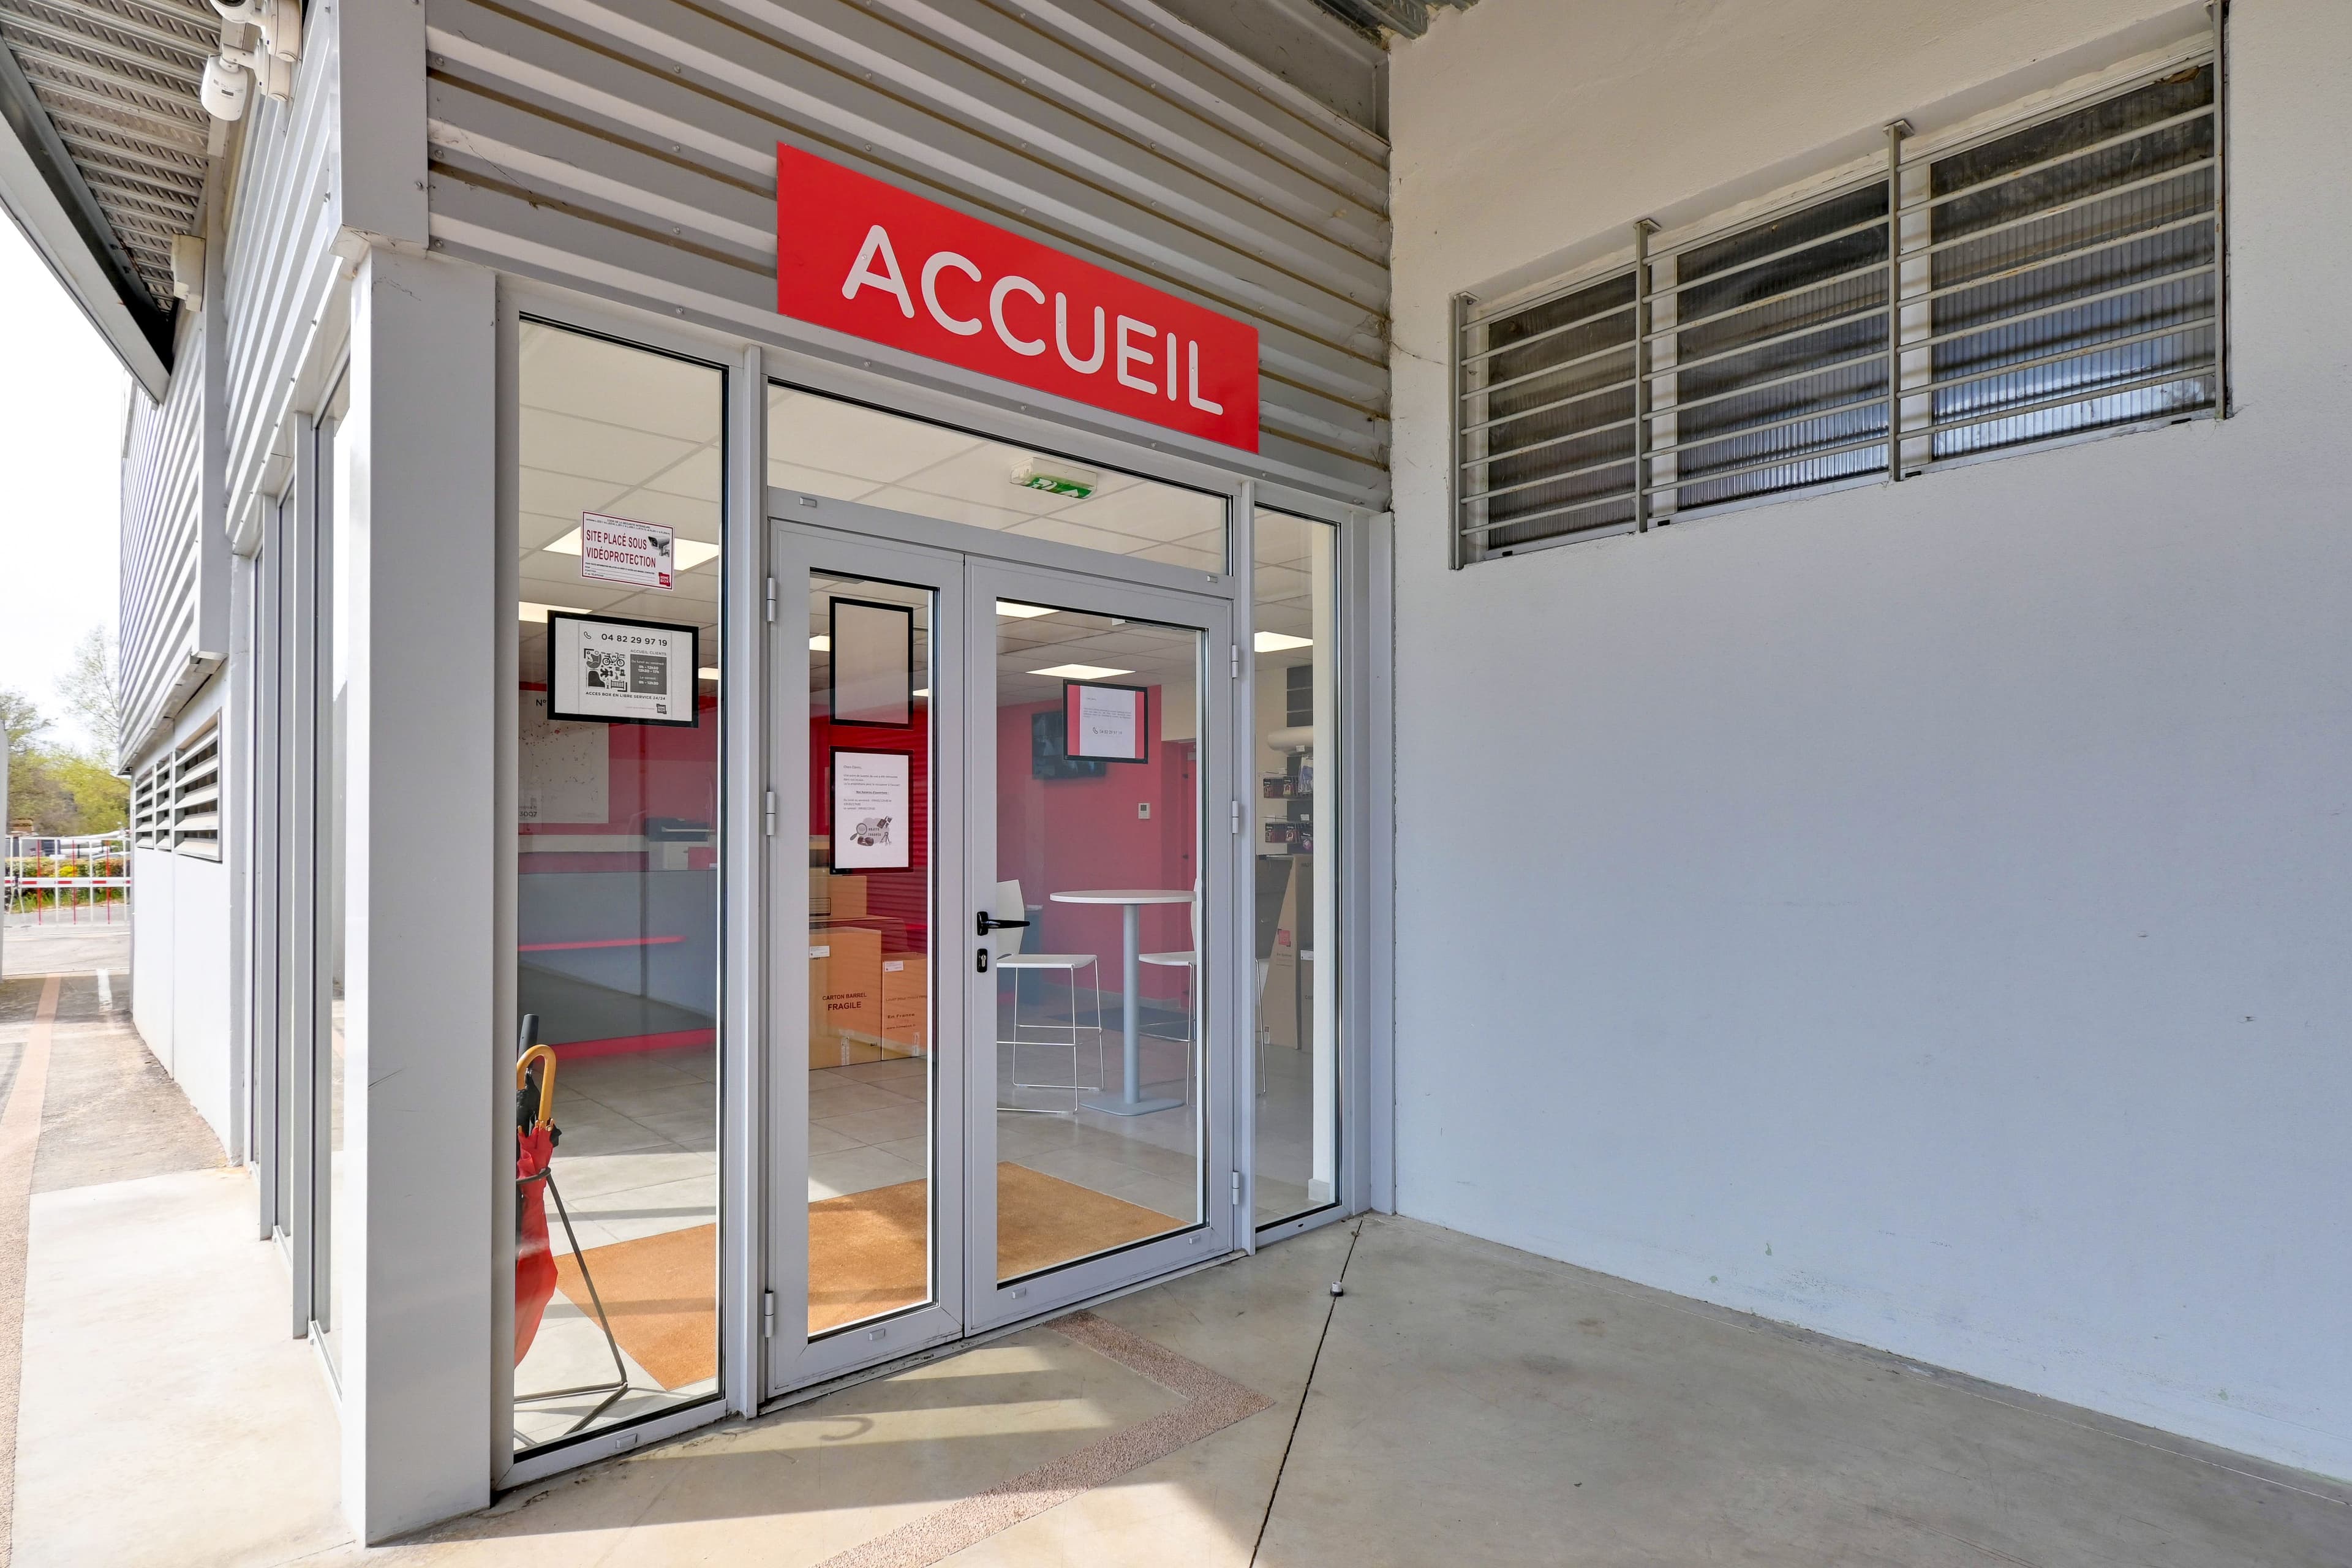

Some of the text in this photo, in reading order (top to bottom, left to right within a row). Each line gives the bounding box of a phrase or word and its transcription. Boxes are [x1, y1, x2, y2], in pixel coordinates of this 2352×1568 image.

[842, 225, 1223, 415] ACCUEIL
[586, 530, 647, 550] SITE PLACÉ SOUS
[586, 546, 656, 568] VIDÉOPROTECTION
[827, 1001, 862, 1011] FRAGILE
